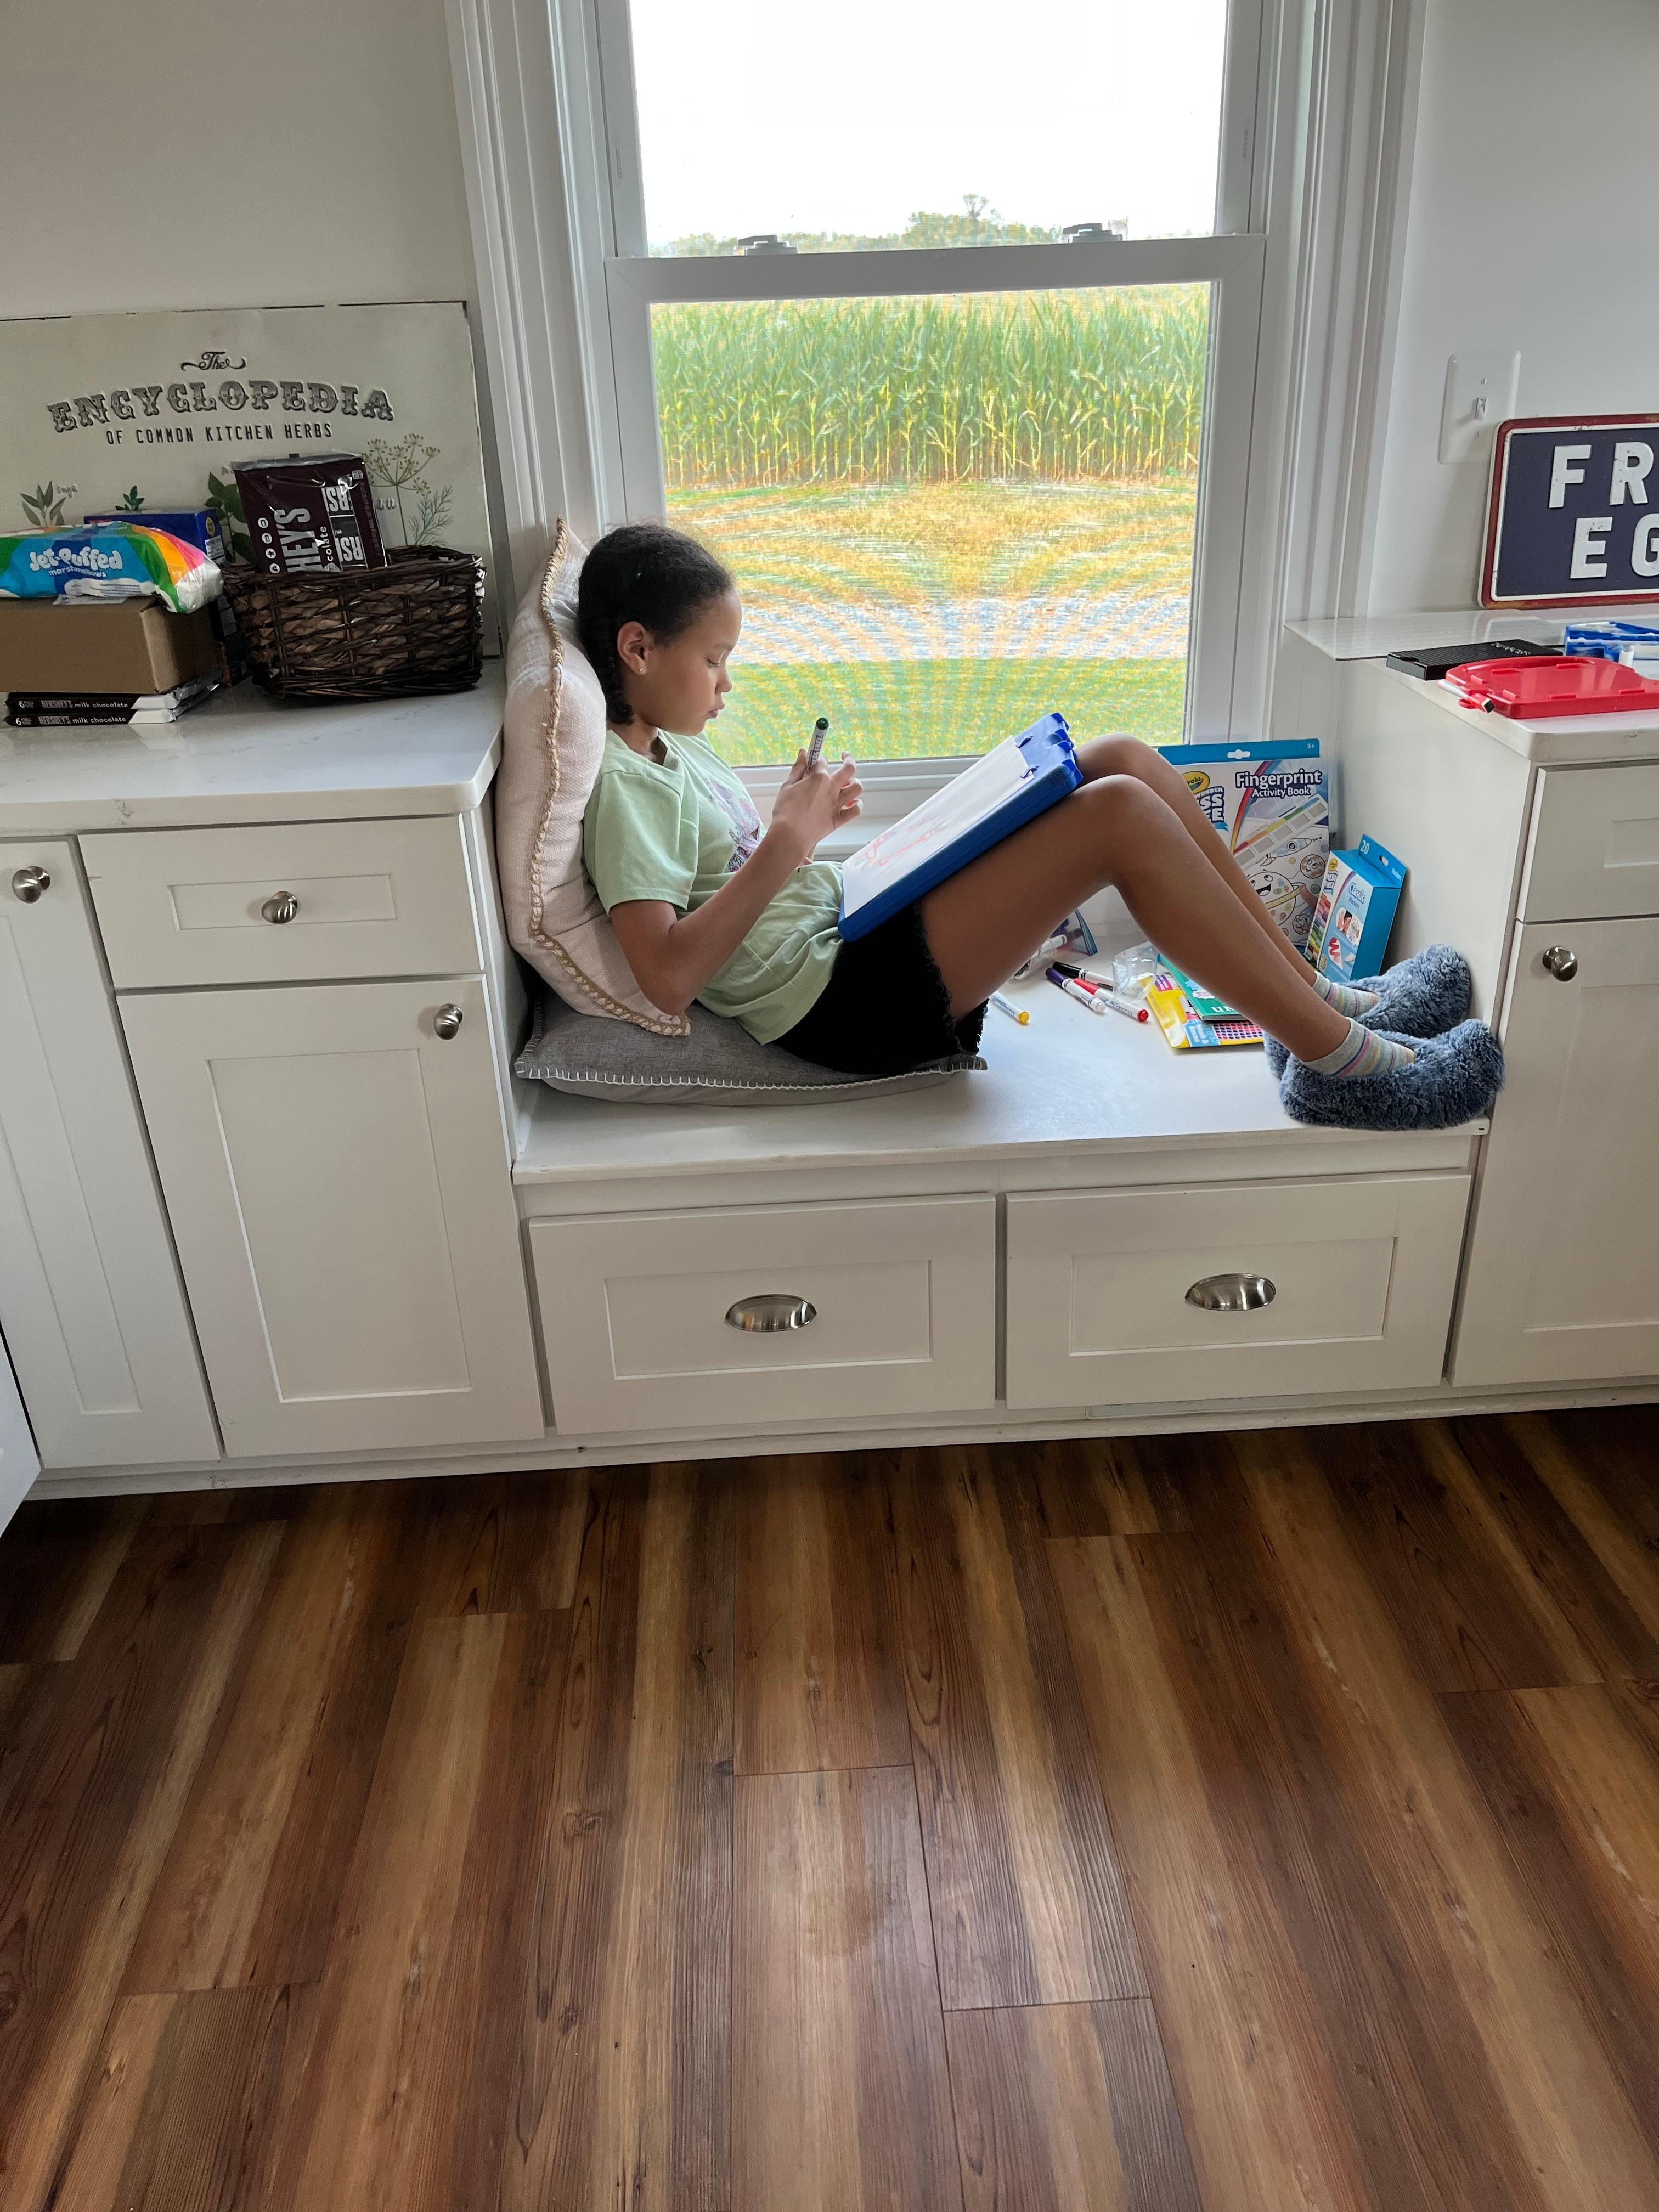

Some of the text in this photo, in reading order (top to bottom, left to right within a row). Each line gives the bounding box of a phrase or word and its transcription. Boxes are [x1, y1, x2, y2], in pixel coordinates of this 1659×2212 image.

[180, 351, 246, 370] The
[47, 381, 393, 433] ENCYCLOPEDIA
[106, 424, 331, 444] OF COMMON KITCHEN HERBS
[29, 546, 123, 571] Jet-Puffed
[48, 565, 107, 577] marshmallows
[38, 716, 71, 724] HERSHEY'S
[1236, 769, 1321, 789] Fingerprint
[1252, 787, 1310, 798] Activity Book
[1360, 840, 1370, 854] 20
[1349, 882, 1365, 904] Classic
[1348, 896, 1360, 910] Markers
